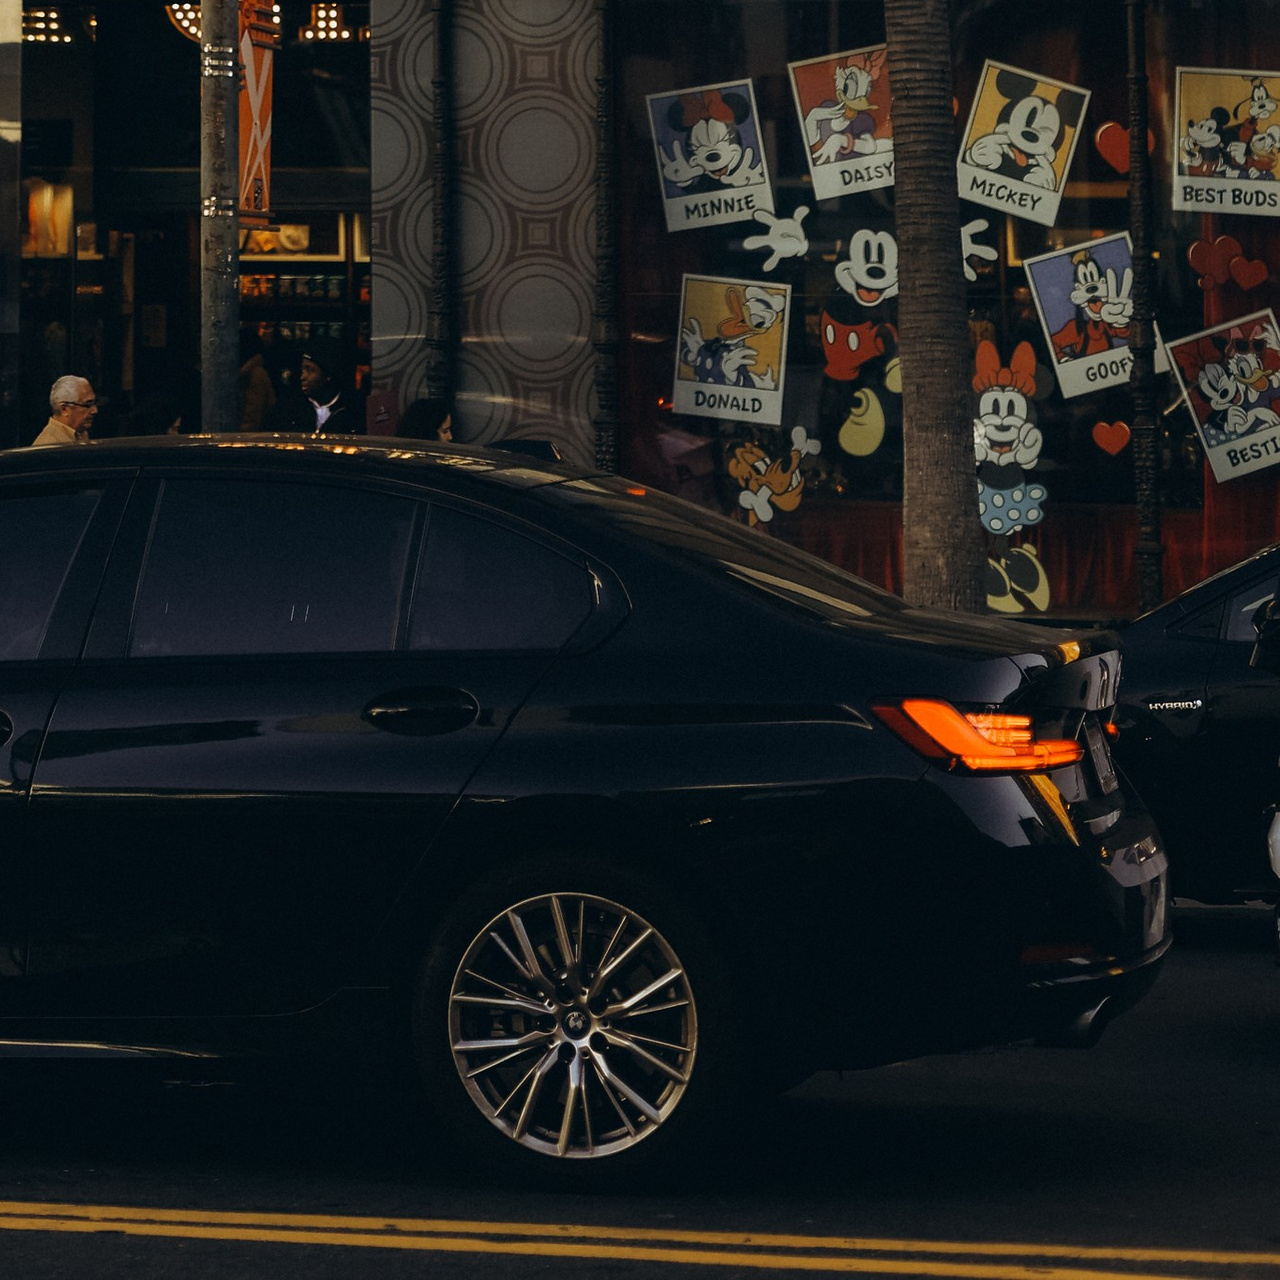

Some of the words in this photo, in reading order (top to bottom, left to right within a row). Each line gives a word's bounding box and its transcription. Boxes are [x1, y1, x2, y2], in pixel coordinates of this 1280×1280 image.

[840, 162, 894, 186] DAISY
[970, 176, 1042, 211] MICKEY
[1183, 185, 1225, 204] BEST
[1231, 188, 1278, 207] BUDS
[684, 194, 756, 220] MINNIE
[694, 390, 762, 413] DONALD
[1148, 701, 1194, 711] HYBRID
